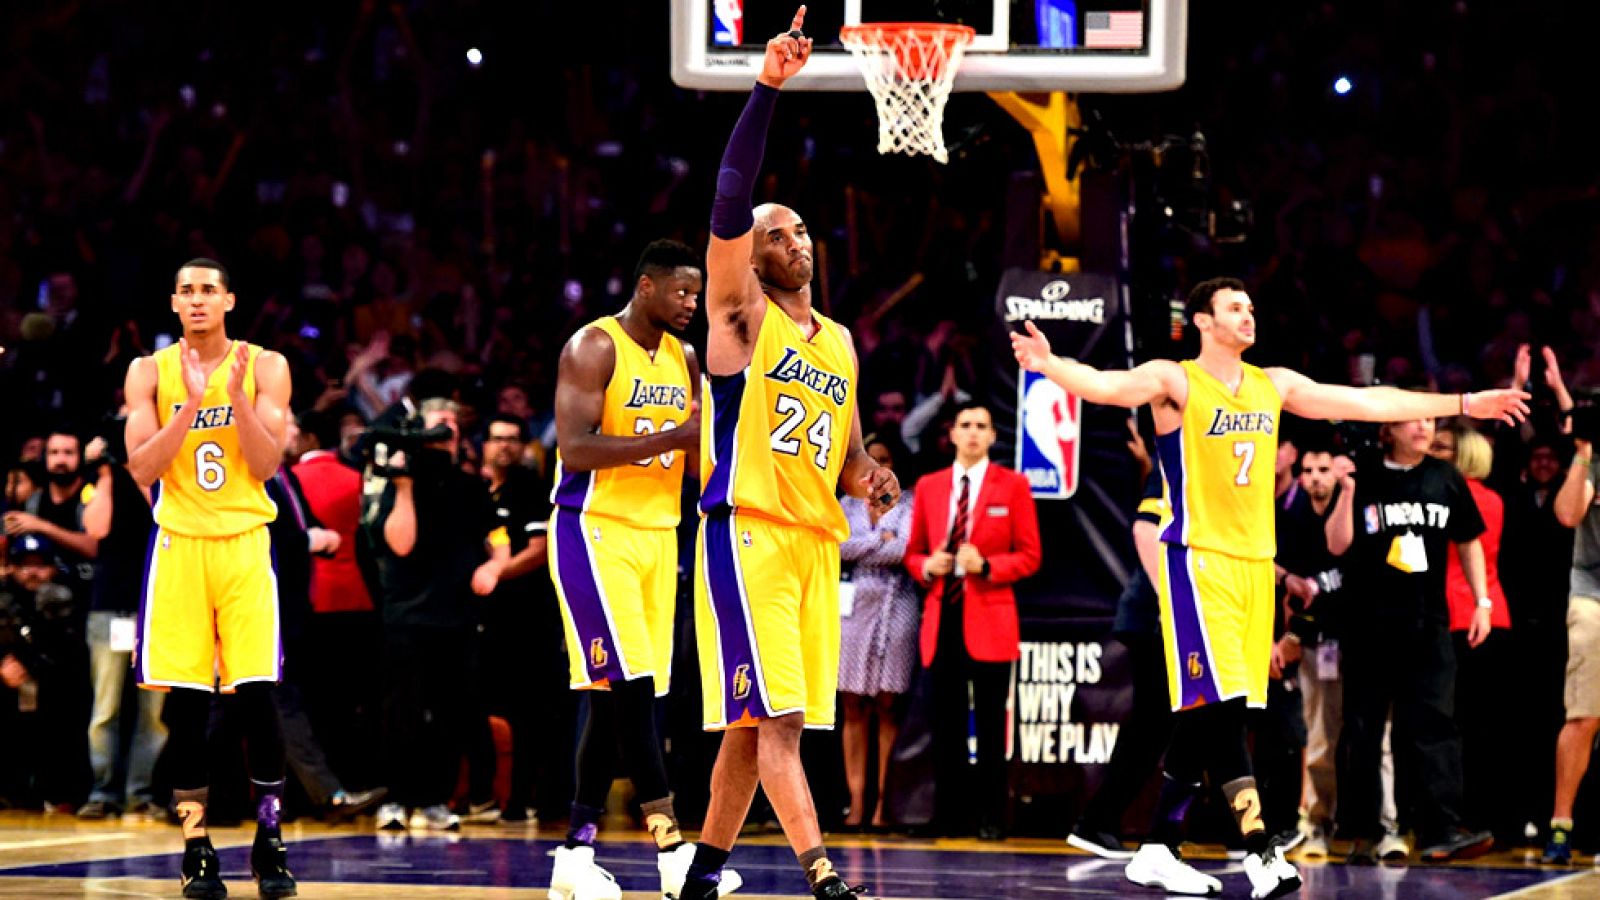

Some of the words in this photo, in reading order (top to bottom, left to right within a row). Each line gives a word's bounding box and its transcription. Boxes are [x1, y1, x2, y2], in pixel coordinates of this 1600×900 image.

[1005, 296, 1104, 324] SPALDING
[625, 378, 685, 410] LAKERS
[764, 347, 849, 405] LAKERS
[770, 393, 832, 470] 24
[195, 441, 225, 492] 6
[1233, 441, 1255, 487] 7
[1425, 502, 1450, 529] TV
[1018, 642, 1074, 682] THIS
[1076, 642, 1102, 684] IS
[1018, 683, 1076, 722] WHY
[1019, 723, 1057, 763] WE
[1059, 723, 1120, 763] PLAY
